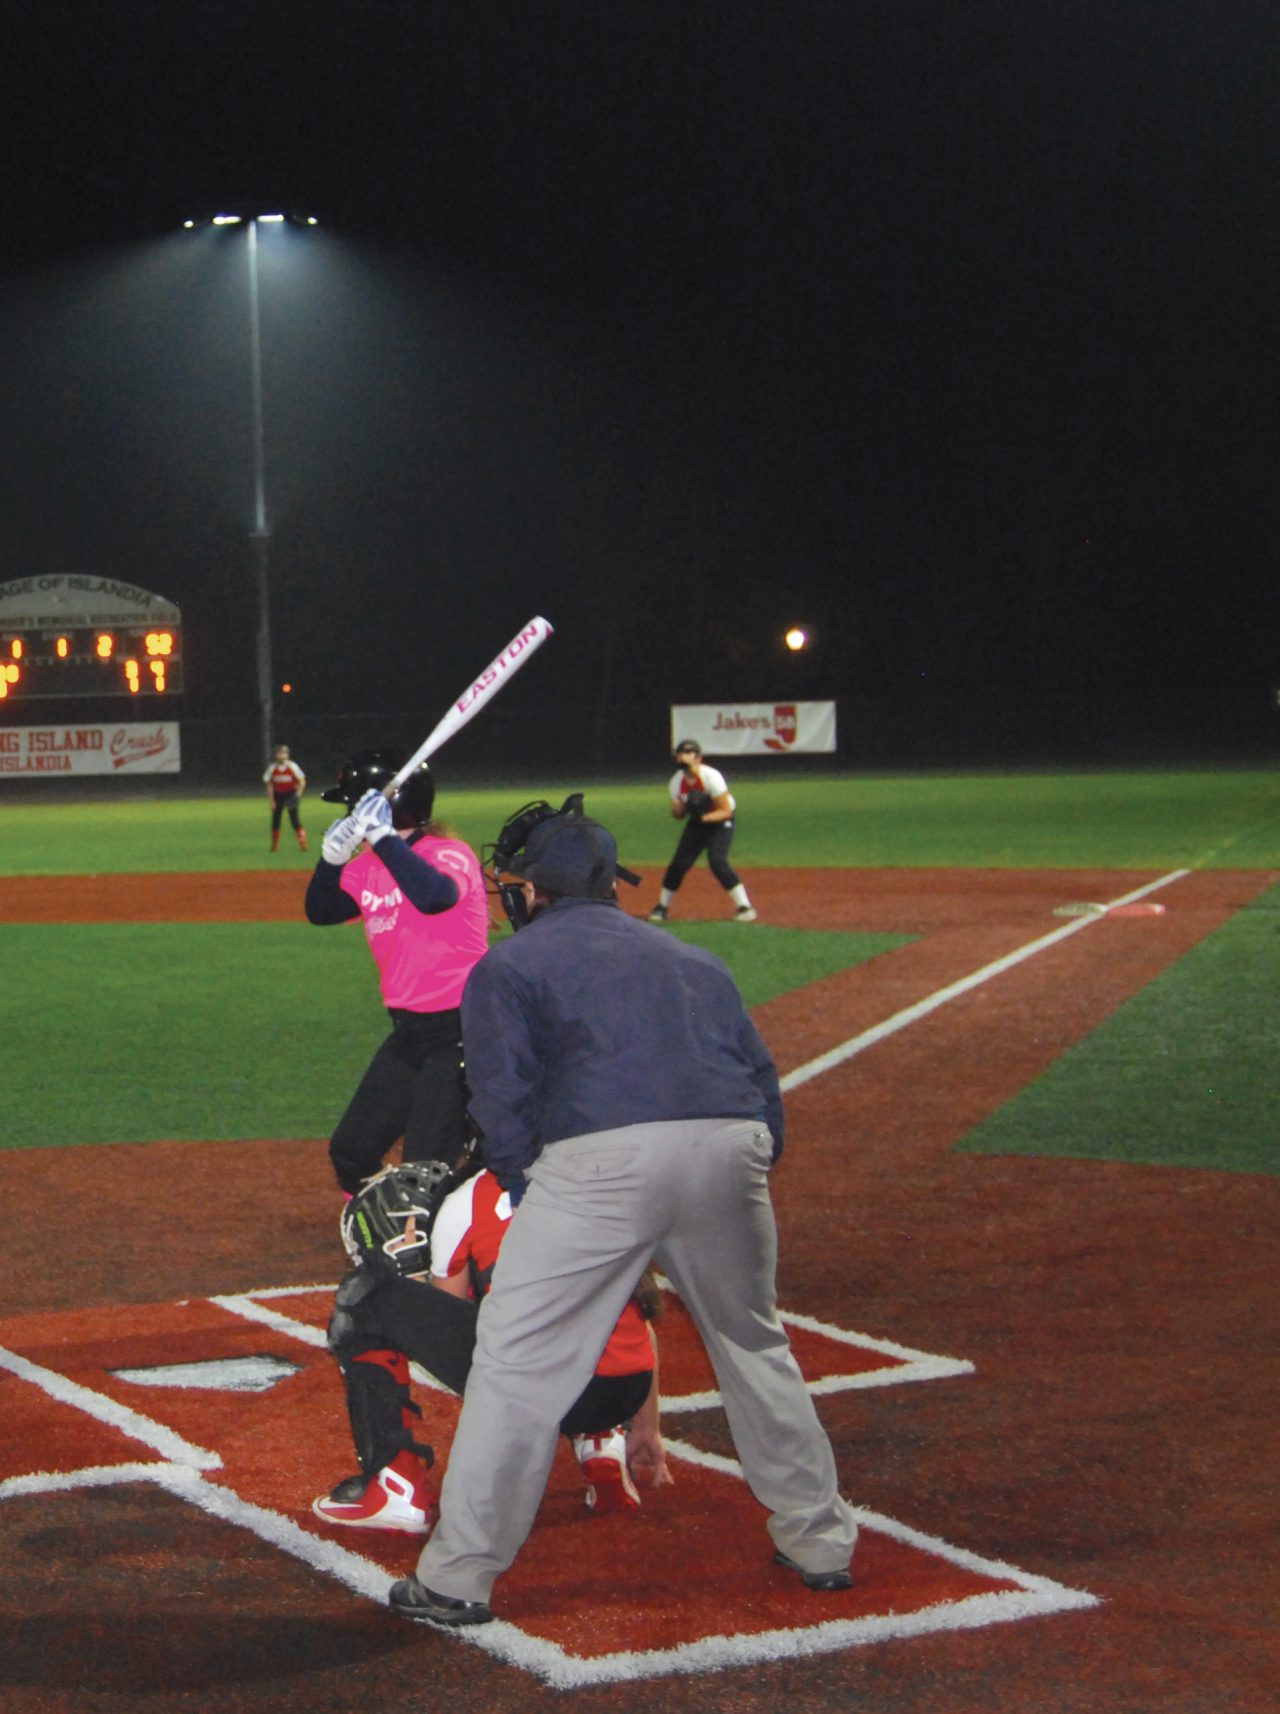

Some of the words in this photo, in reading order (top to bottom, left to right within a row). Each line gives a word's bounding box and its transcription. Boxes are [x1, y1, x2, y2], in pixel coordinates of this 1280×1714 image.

[39, 575, 64, 590] OF
[68, 577, 151, 608] ISLANDIA
[457, 624, 538, 713] EASTON
[28, 729, 104, 752] ISLAND
[110, 725, 170, 756] Crush
[0, 754, 73, 772] ISLANDIA
